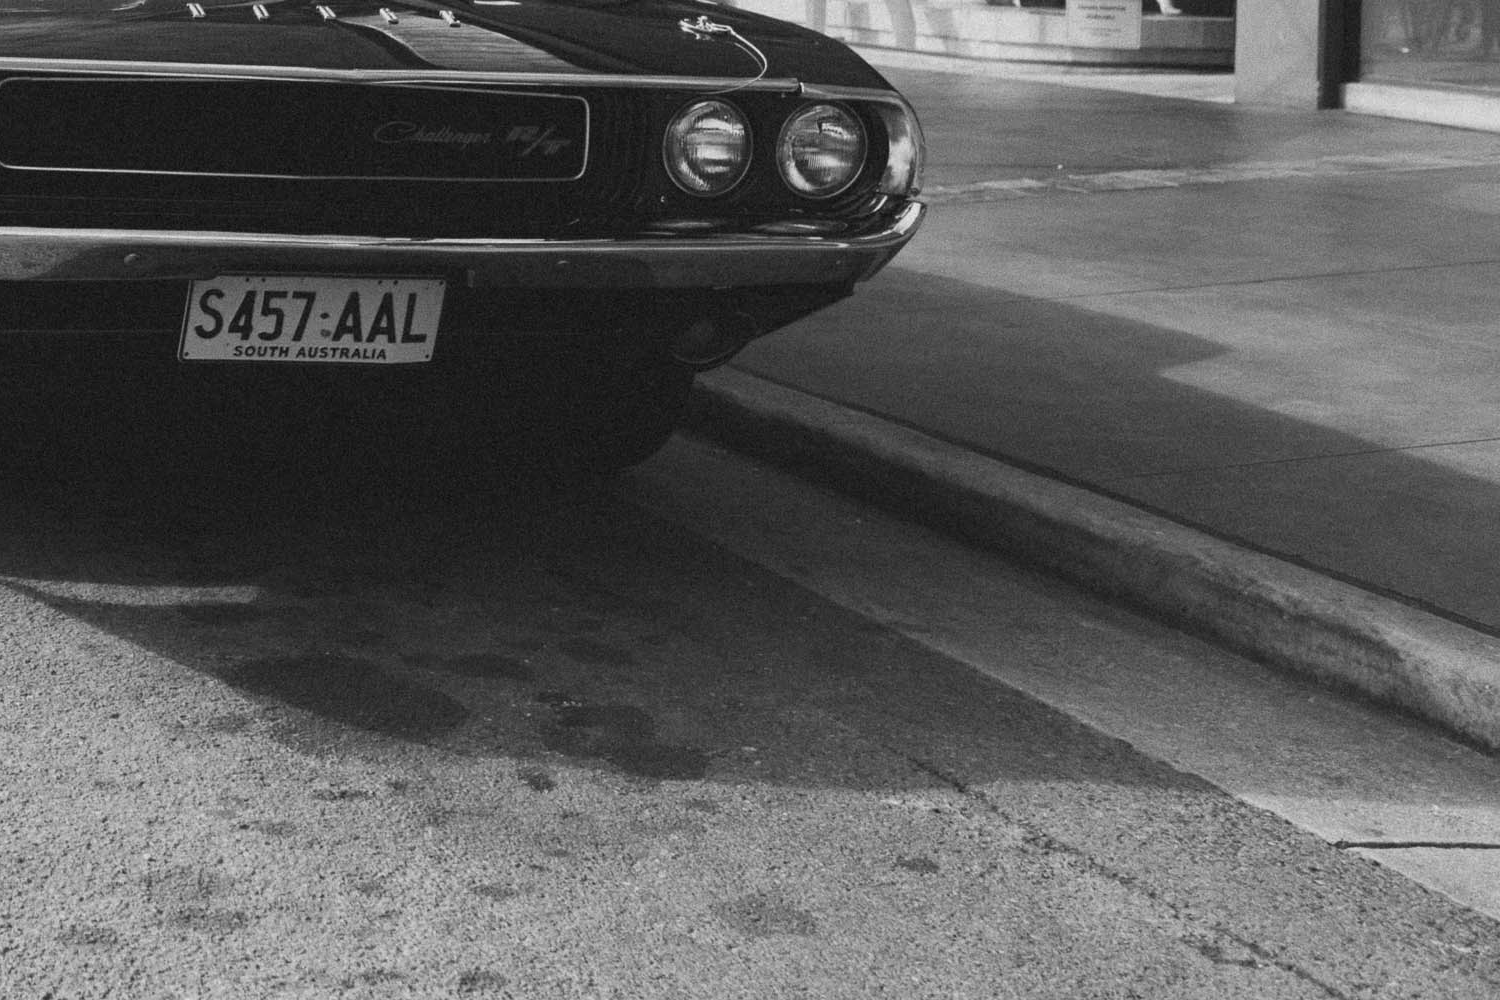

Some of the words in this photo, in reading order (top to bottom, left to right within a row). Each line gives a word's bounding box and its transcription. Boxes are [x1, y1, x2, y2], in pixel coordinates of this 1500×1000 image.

[373, 120, 491, 150] Challenger
[505, 124, 572, 157] R/T
[233, 345, 290, 358] SOUTH
[296, 346, 387, 360] AUSTRALIA
